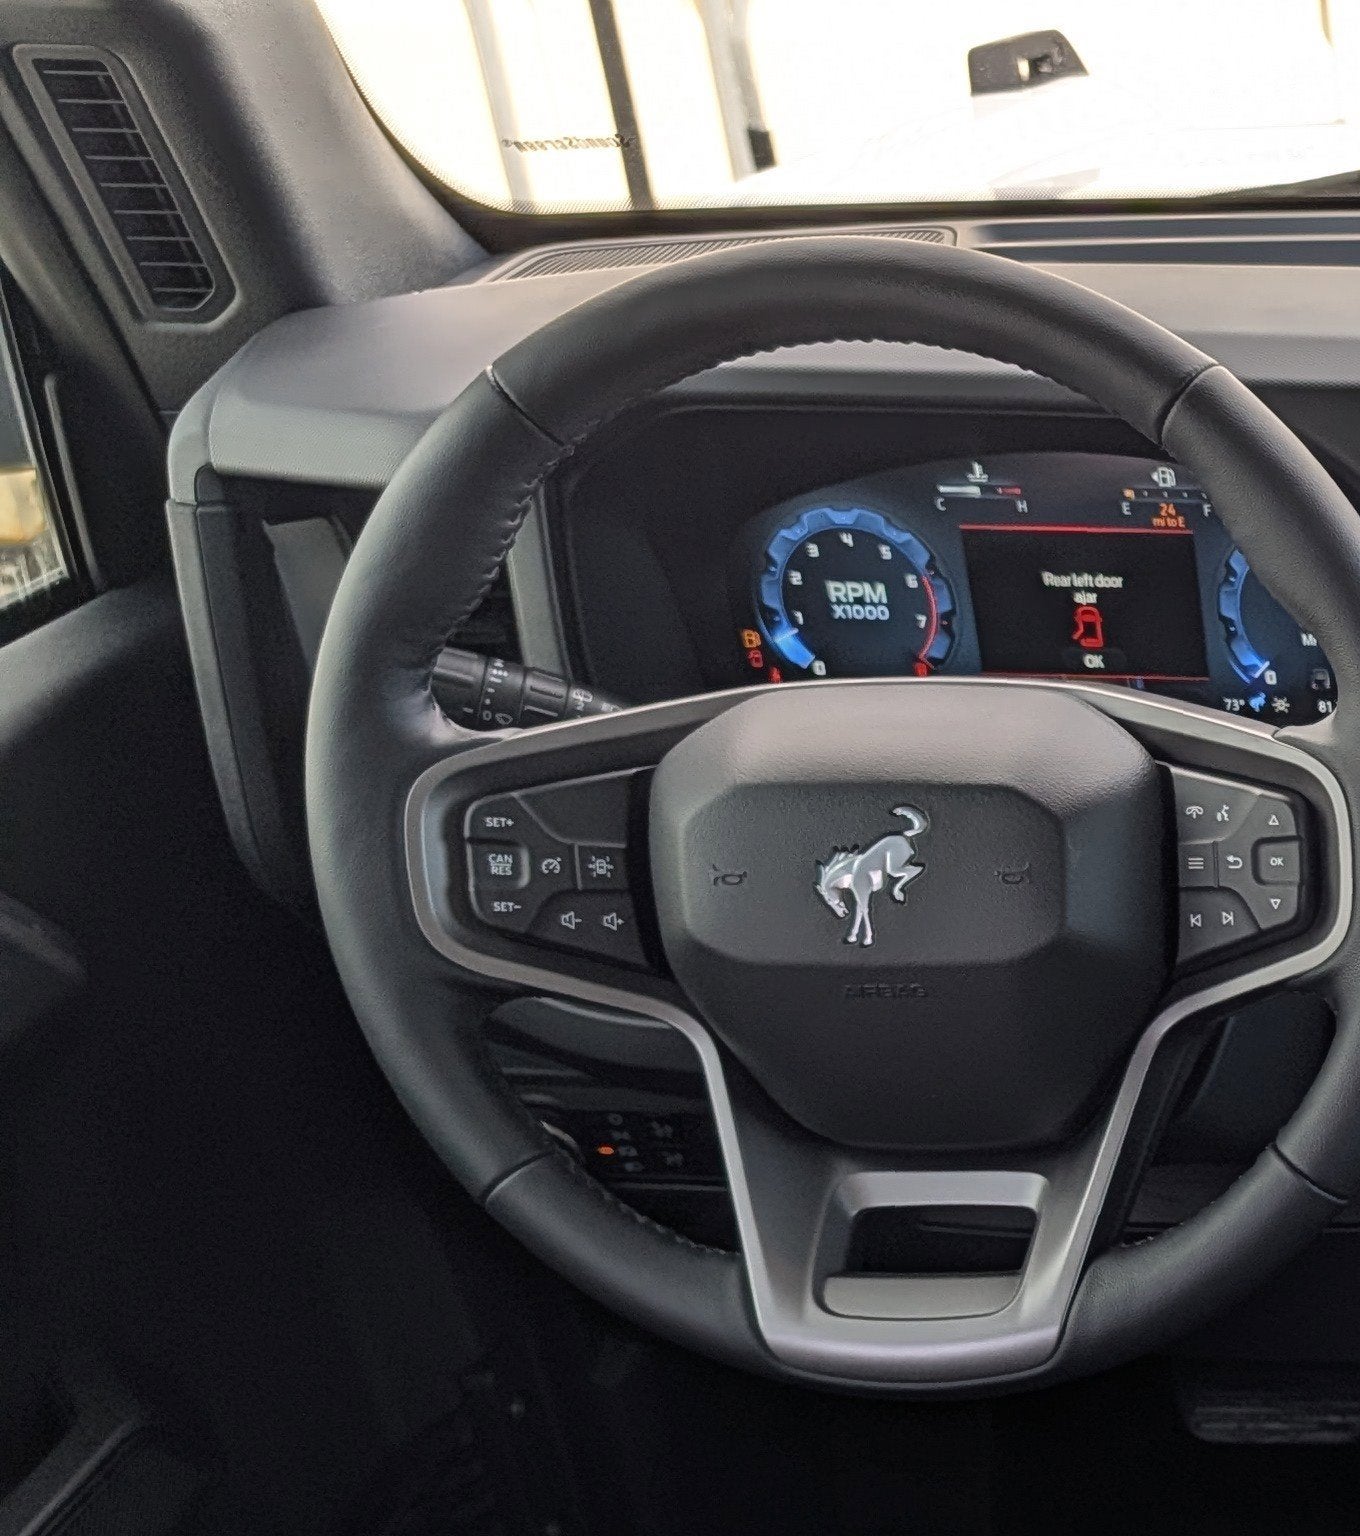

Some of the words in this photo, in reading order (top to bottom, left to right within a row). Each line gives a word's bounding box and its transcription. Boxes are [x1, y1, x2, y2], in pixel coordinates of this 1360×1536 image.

[1016, 501, 1028, 513] H
[1121, 502, 1131, 516] E
[1159, 503, 1177, 516] 24
[1202, 503, 1212, 517] F
[840, 532, 853, 547] 4
[806, 543, 819, 558] 3
[788, 570, 803, 586] 2
[1041, 571, 1072, 588] Rear
[1072, 572, 1094, 588] left
[1094, 572, 1124, 588] door
[824, 580, 888, 604] RPM
[793, 610, 804, 625] 1
[831, 604, 890, 620] X1000
[915, 614, 927, 629] 7
[812, 660, 826, 676] 0
[1083, 654, 1105, 669] OK
[485, 817, 514, 828] SET+
[488, 853, 513, 864] CAN
[1269, 856, 1285, 867] OK
[491, 865, 512, 876] RES
